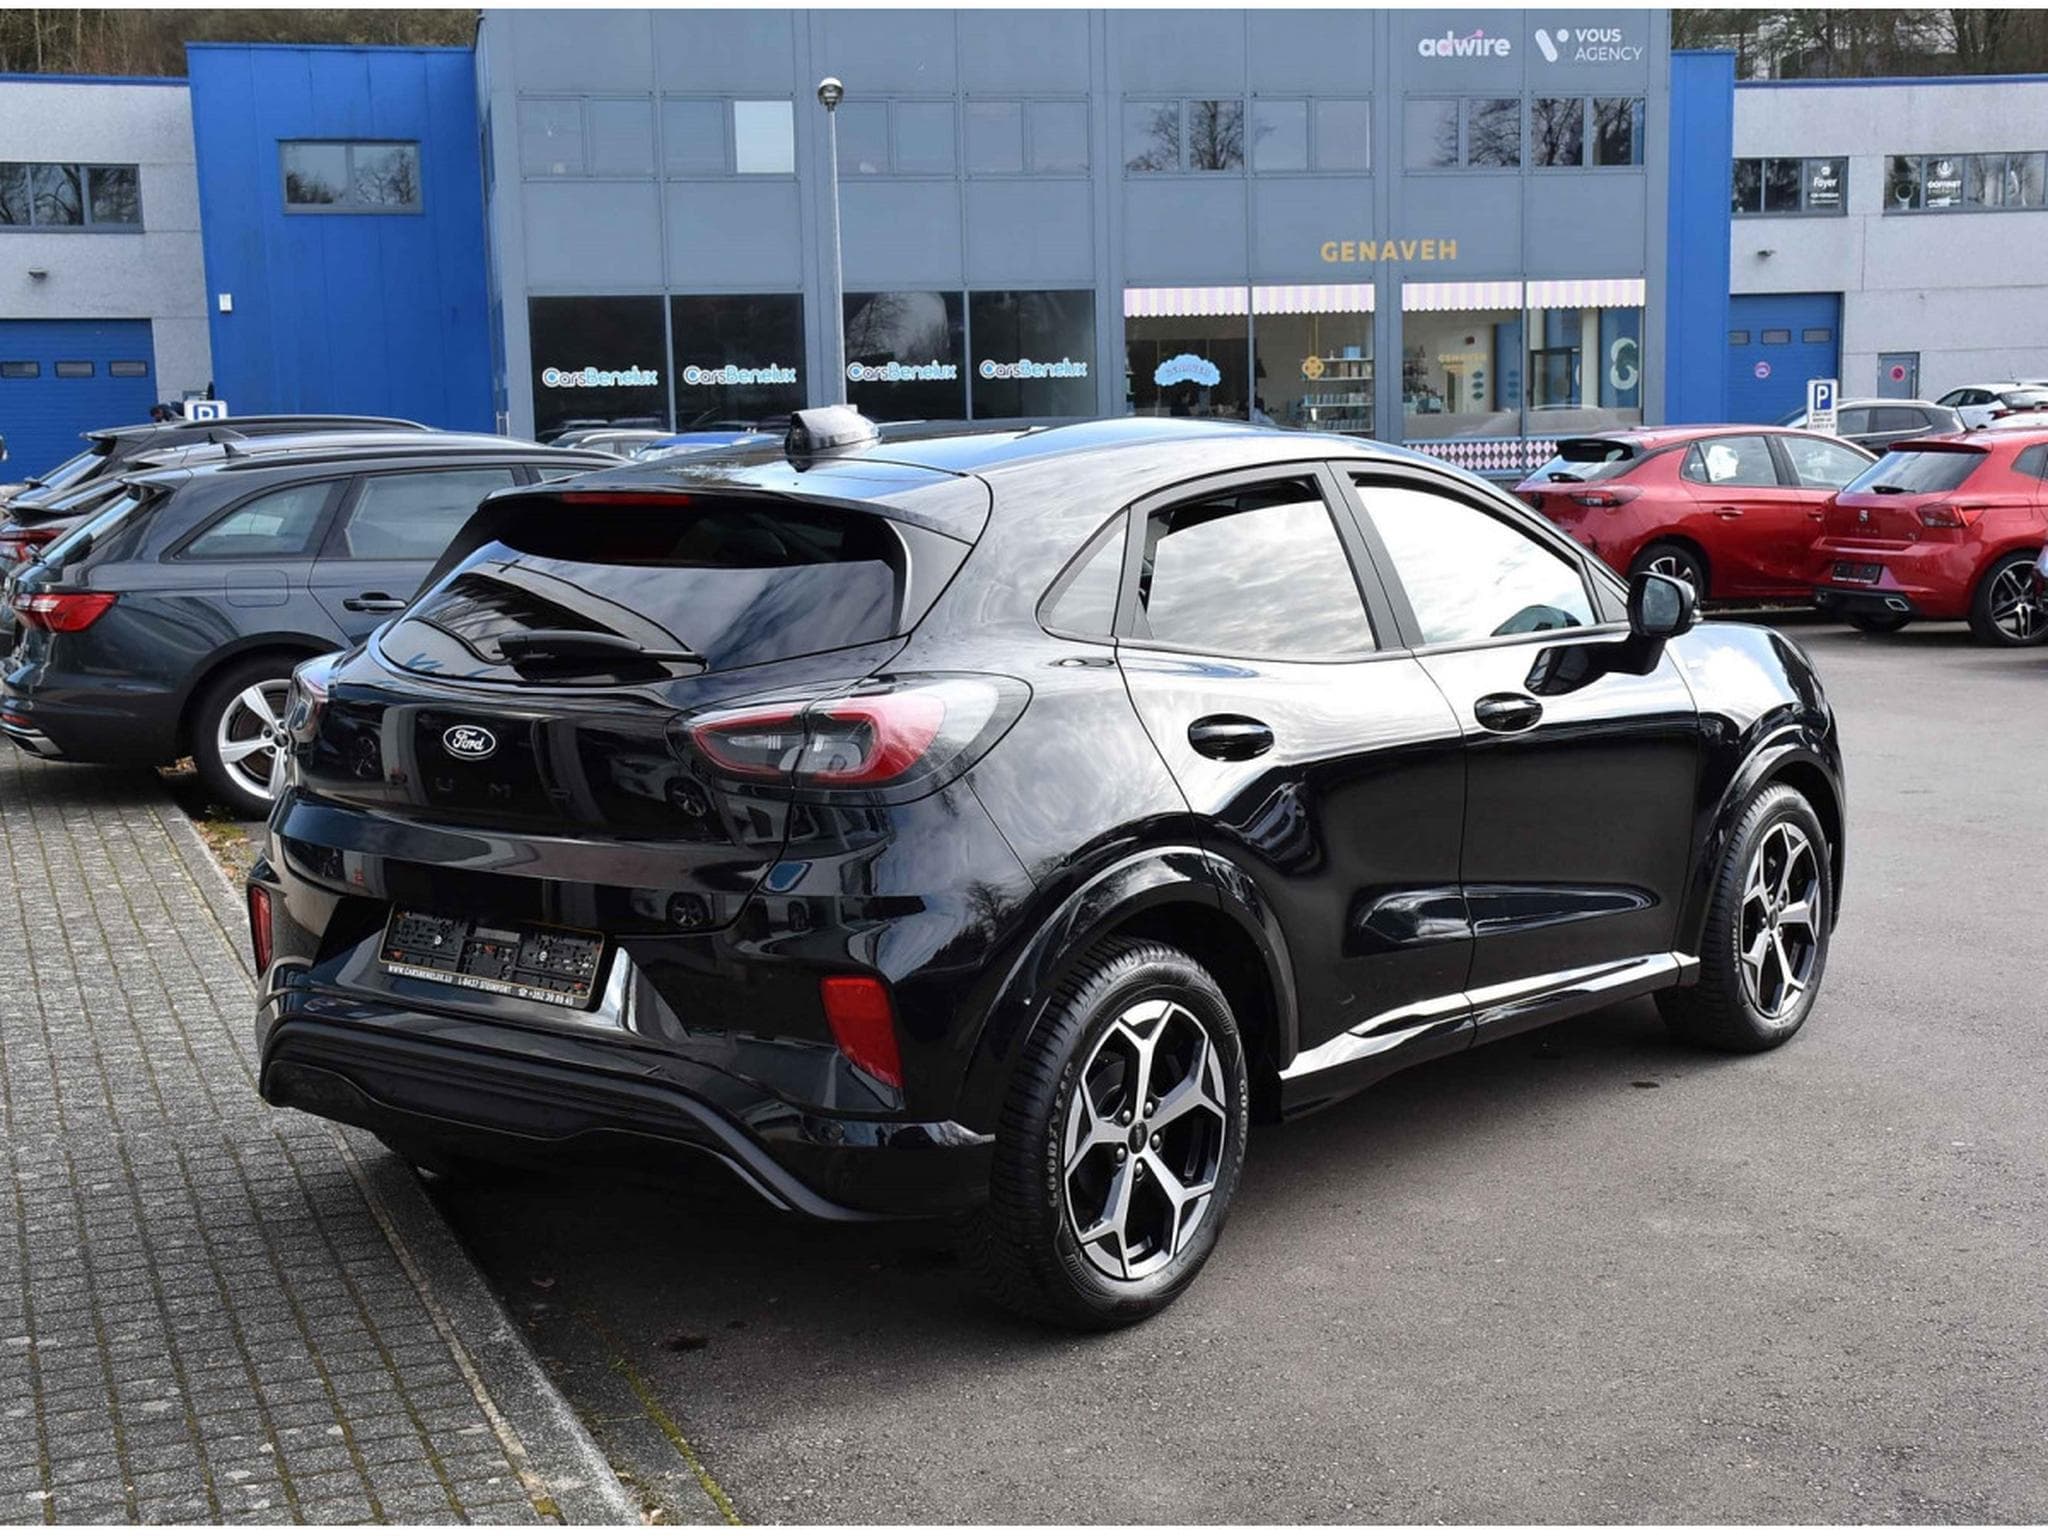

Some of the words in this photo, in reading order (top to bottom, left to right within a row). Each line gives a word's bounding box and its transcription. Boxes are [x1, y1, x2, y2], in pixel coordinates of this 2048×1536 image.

[1418, 29, 1512, 57] adwire
[1574, 28, 1622, 43] VOUS
[1574, 46, 1643, 61] AGENCY
[1813, 176, 1838, 190] Foyer
[1320, 239, 1458, 263] GENAVEH
[542, 365, 658, 388] CarsBenelux
[683, 363, 797, 386] CarsBenelux
[847, 359, 957, 382] CarsBenelux
[979, 357, 1088, 380] CarsBenelux
[1816, 385, 1829, 409] P
[198, 406, 214, 420] P
[452, 729, 485, 752] Ford
